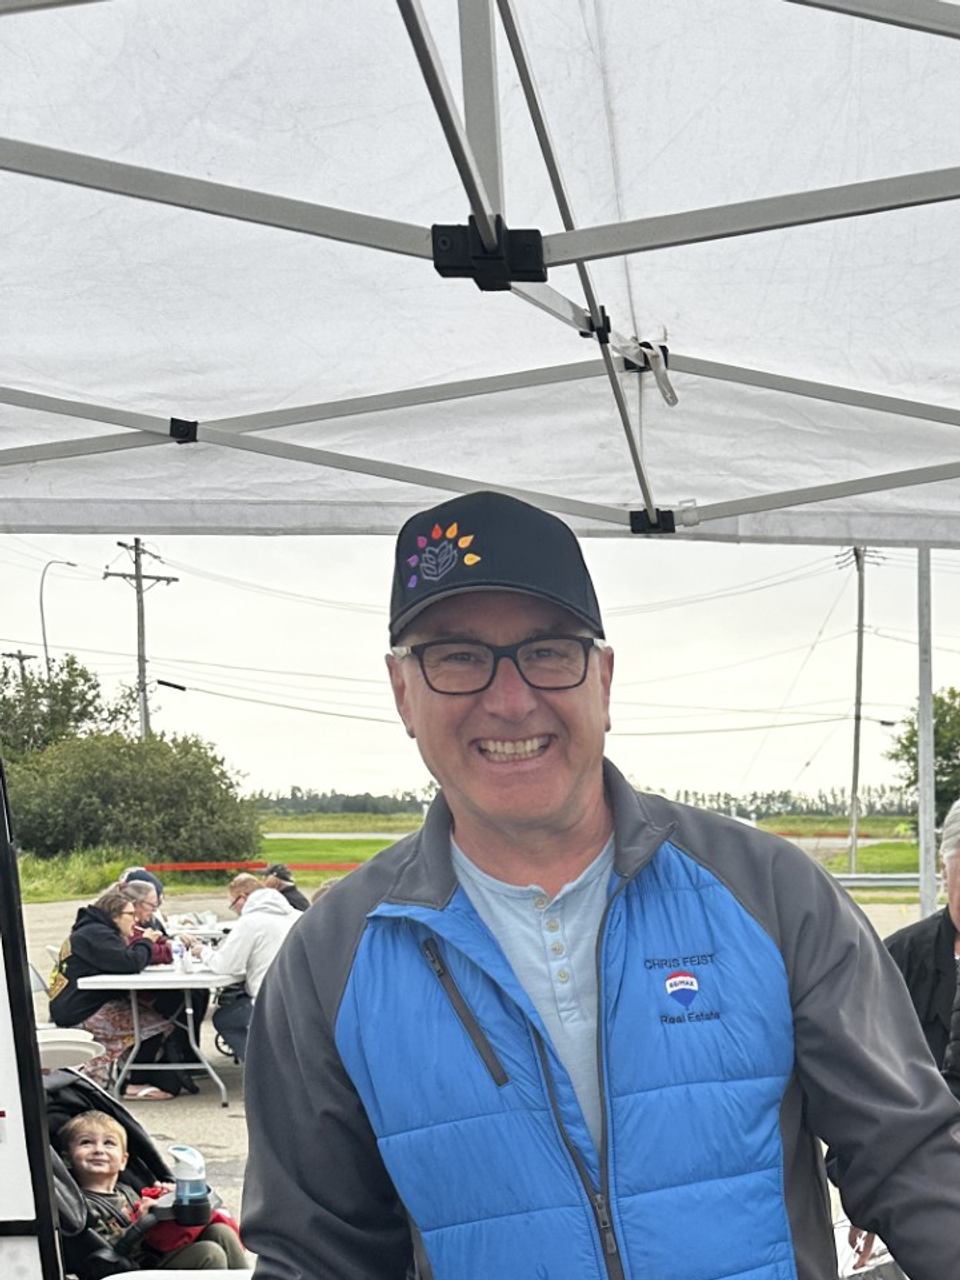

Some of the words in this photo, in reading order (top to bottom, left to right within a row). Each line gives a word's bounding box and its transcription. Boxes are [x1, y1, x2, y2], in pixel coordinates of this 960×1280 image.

[643, 958, 681, 970] CHRIS
[682, 953, 715, 968] FEIST
[660, 1013, 686, 1025] Real
[688, 1010, 721, 1023] Estate
